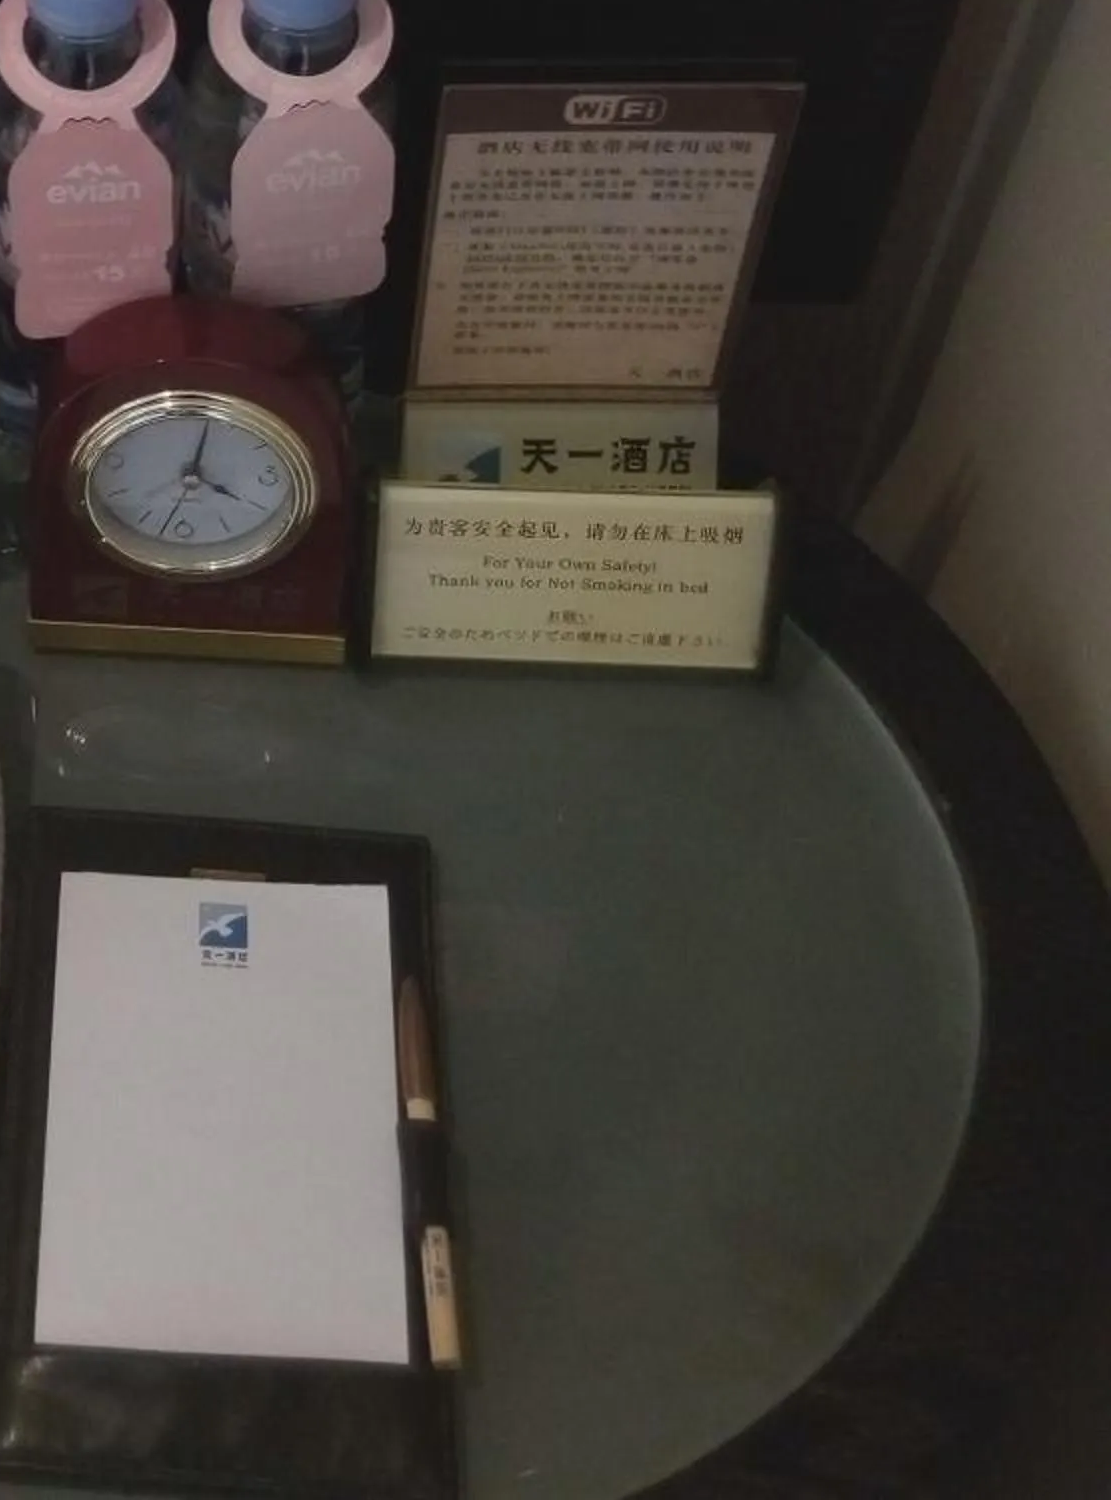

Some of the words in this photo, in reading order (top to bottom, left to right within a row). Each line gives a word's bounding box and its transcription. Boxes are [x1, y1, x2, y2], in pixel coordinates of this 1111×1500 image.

[46, 179, 142, 205] evian
[265, 164, 362, 194] evian
[520, 436, 697, 475] 天一酒店
[483, 555, 510, 570] For
[515, 557, 555, 571] Your
[558, 558, 597, 573] Own
[429, 573, 480, 589] Thank
[485, 578, 515, 591] you
[520, 576, 543, 590] for
[548, 577, 576, 591] Not
[582, 579, 653, 595] Smoking
[658, 581, 674, 594] in
[680, 581, 709, 595] bed
